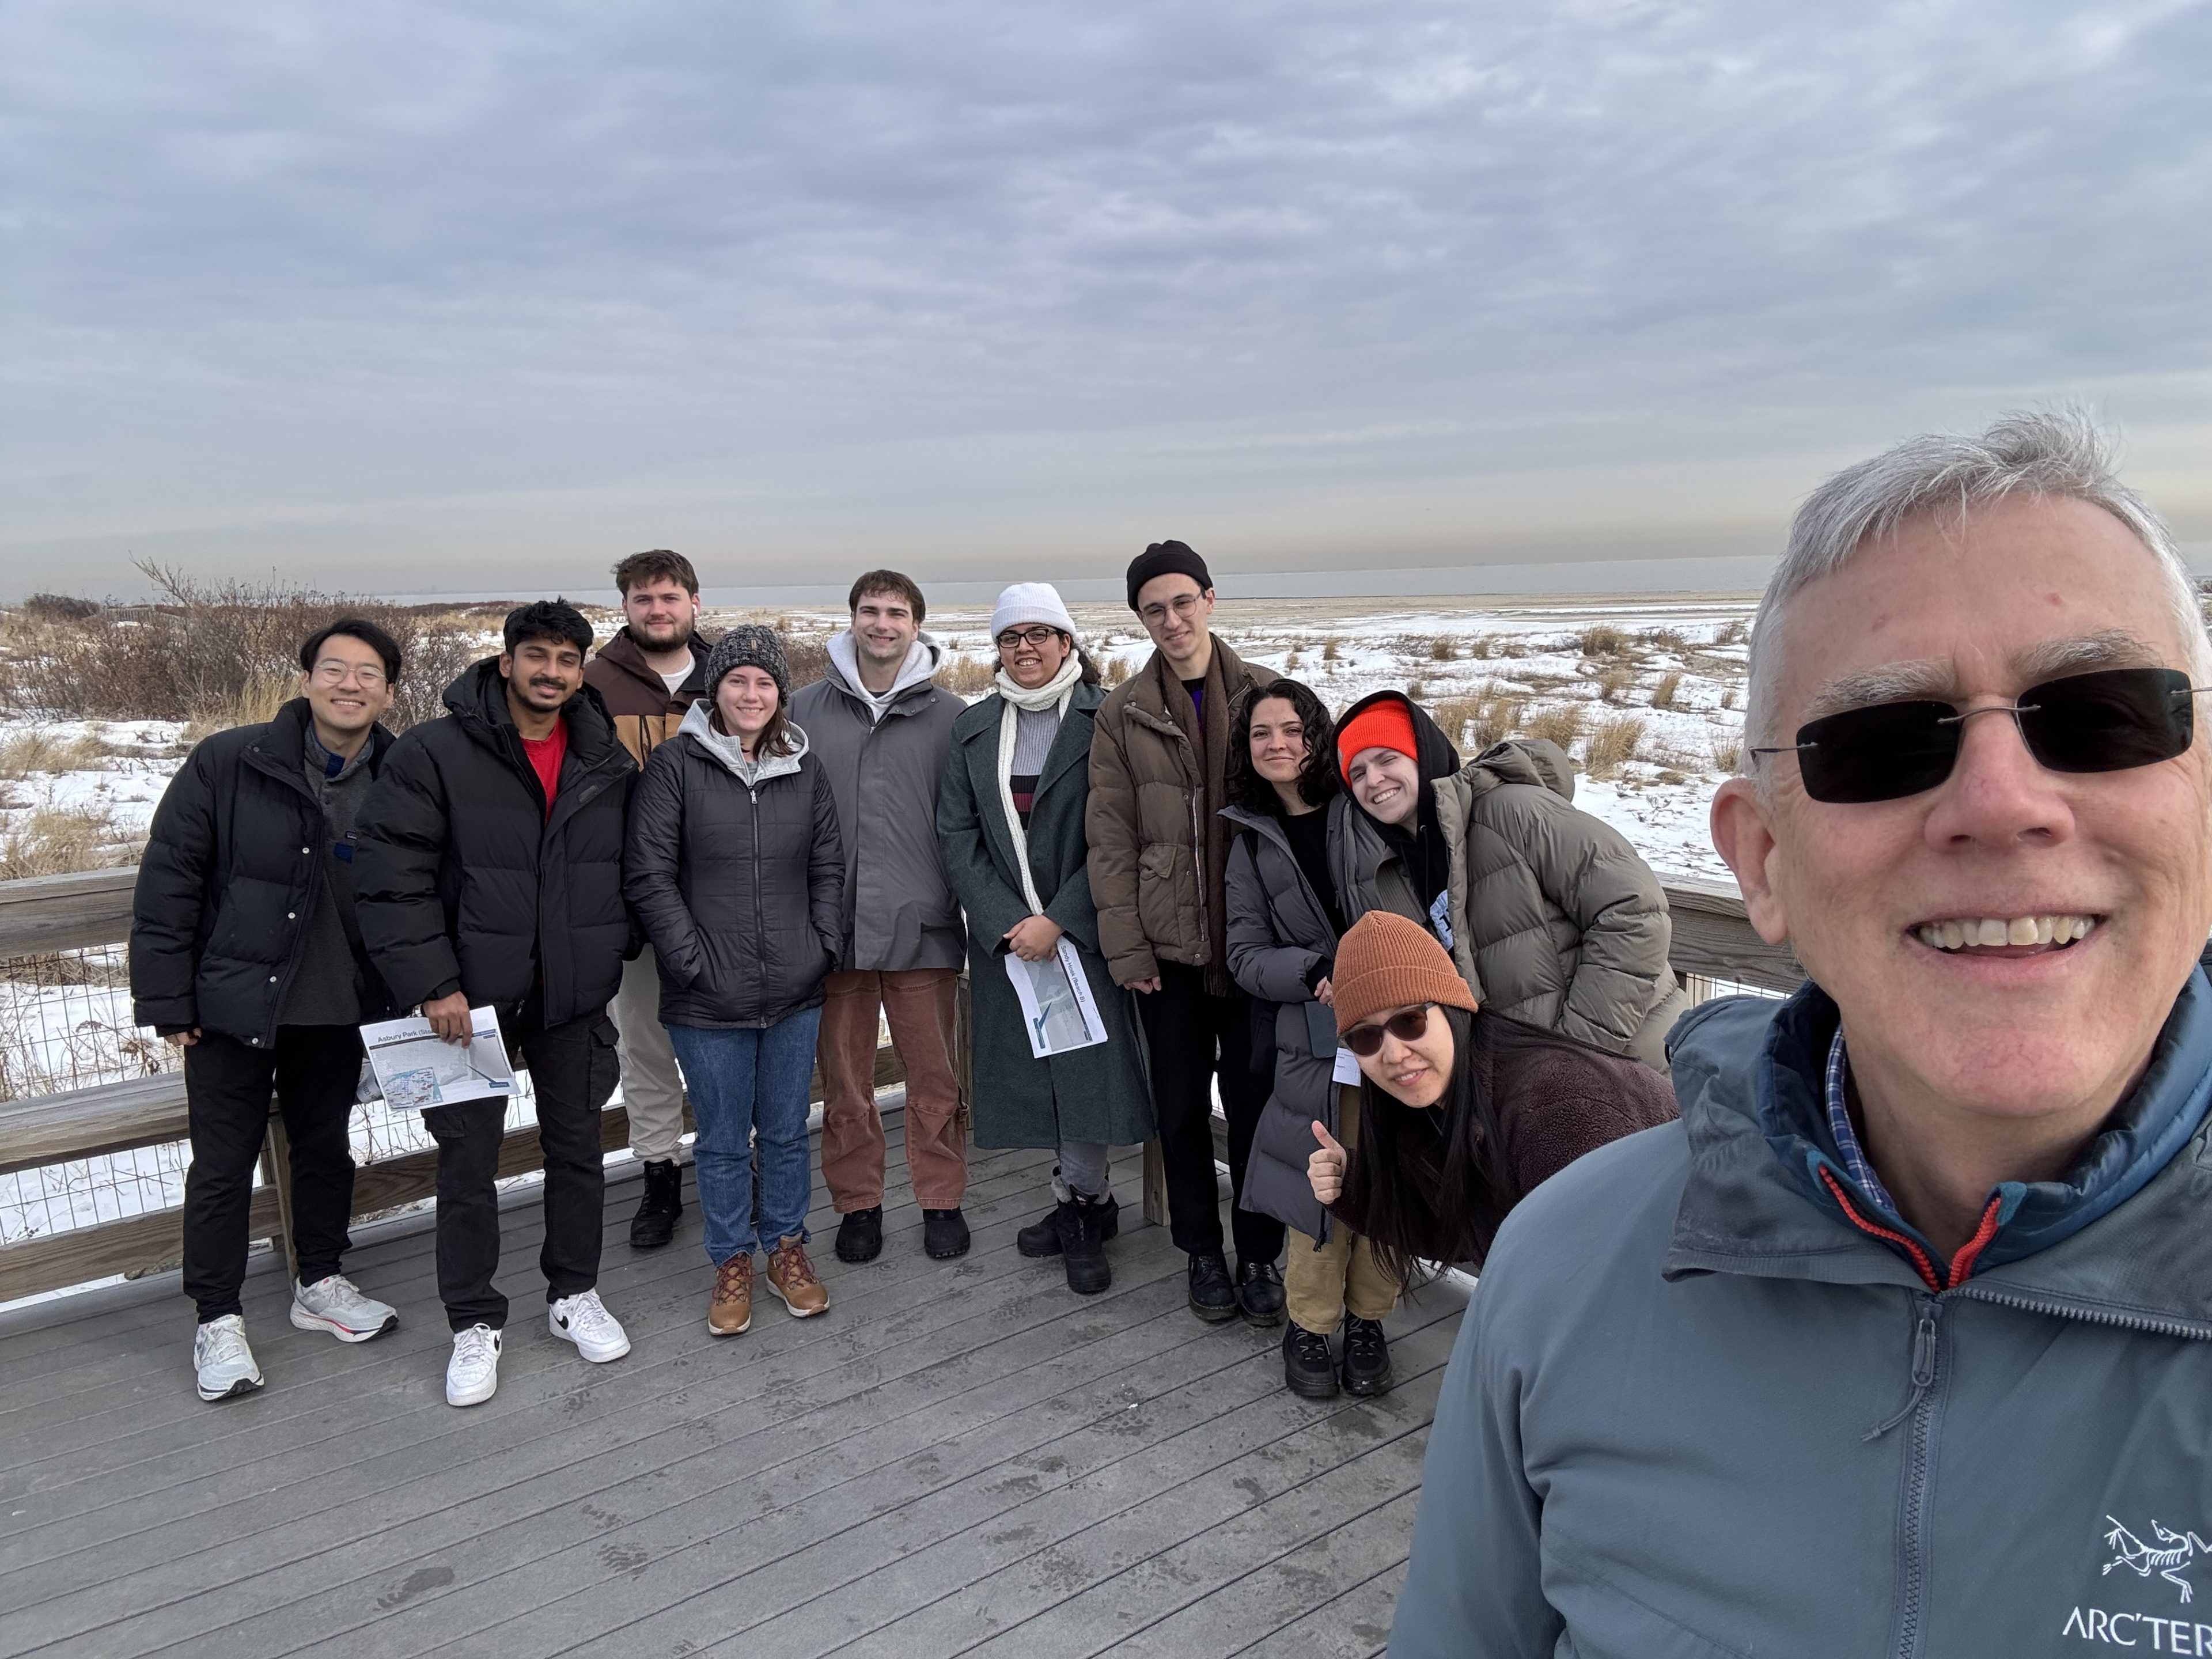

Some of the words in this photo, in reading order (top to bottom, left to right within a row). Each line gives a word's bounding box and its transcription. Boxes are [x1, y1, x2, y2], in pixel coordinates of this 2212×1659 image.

[1061, 945, 1070, 962] Sandy
[1067, 963, 1075, 977] Hook
[1072, 978, 1082, 996] (Beach
[378, 1033, 402, 1043] Asbury
[403, 1030, 417, 1038] Park
